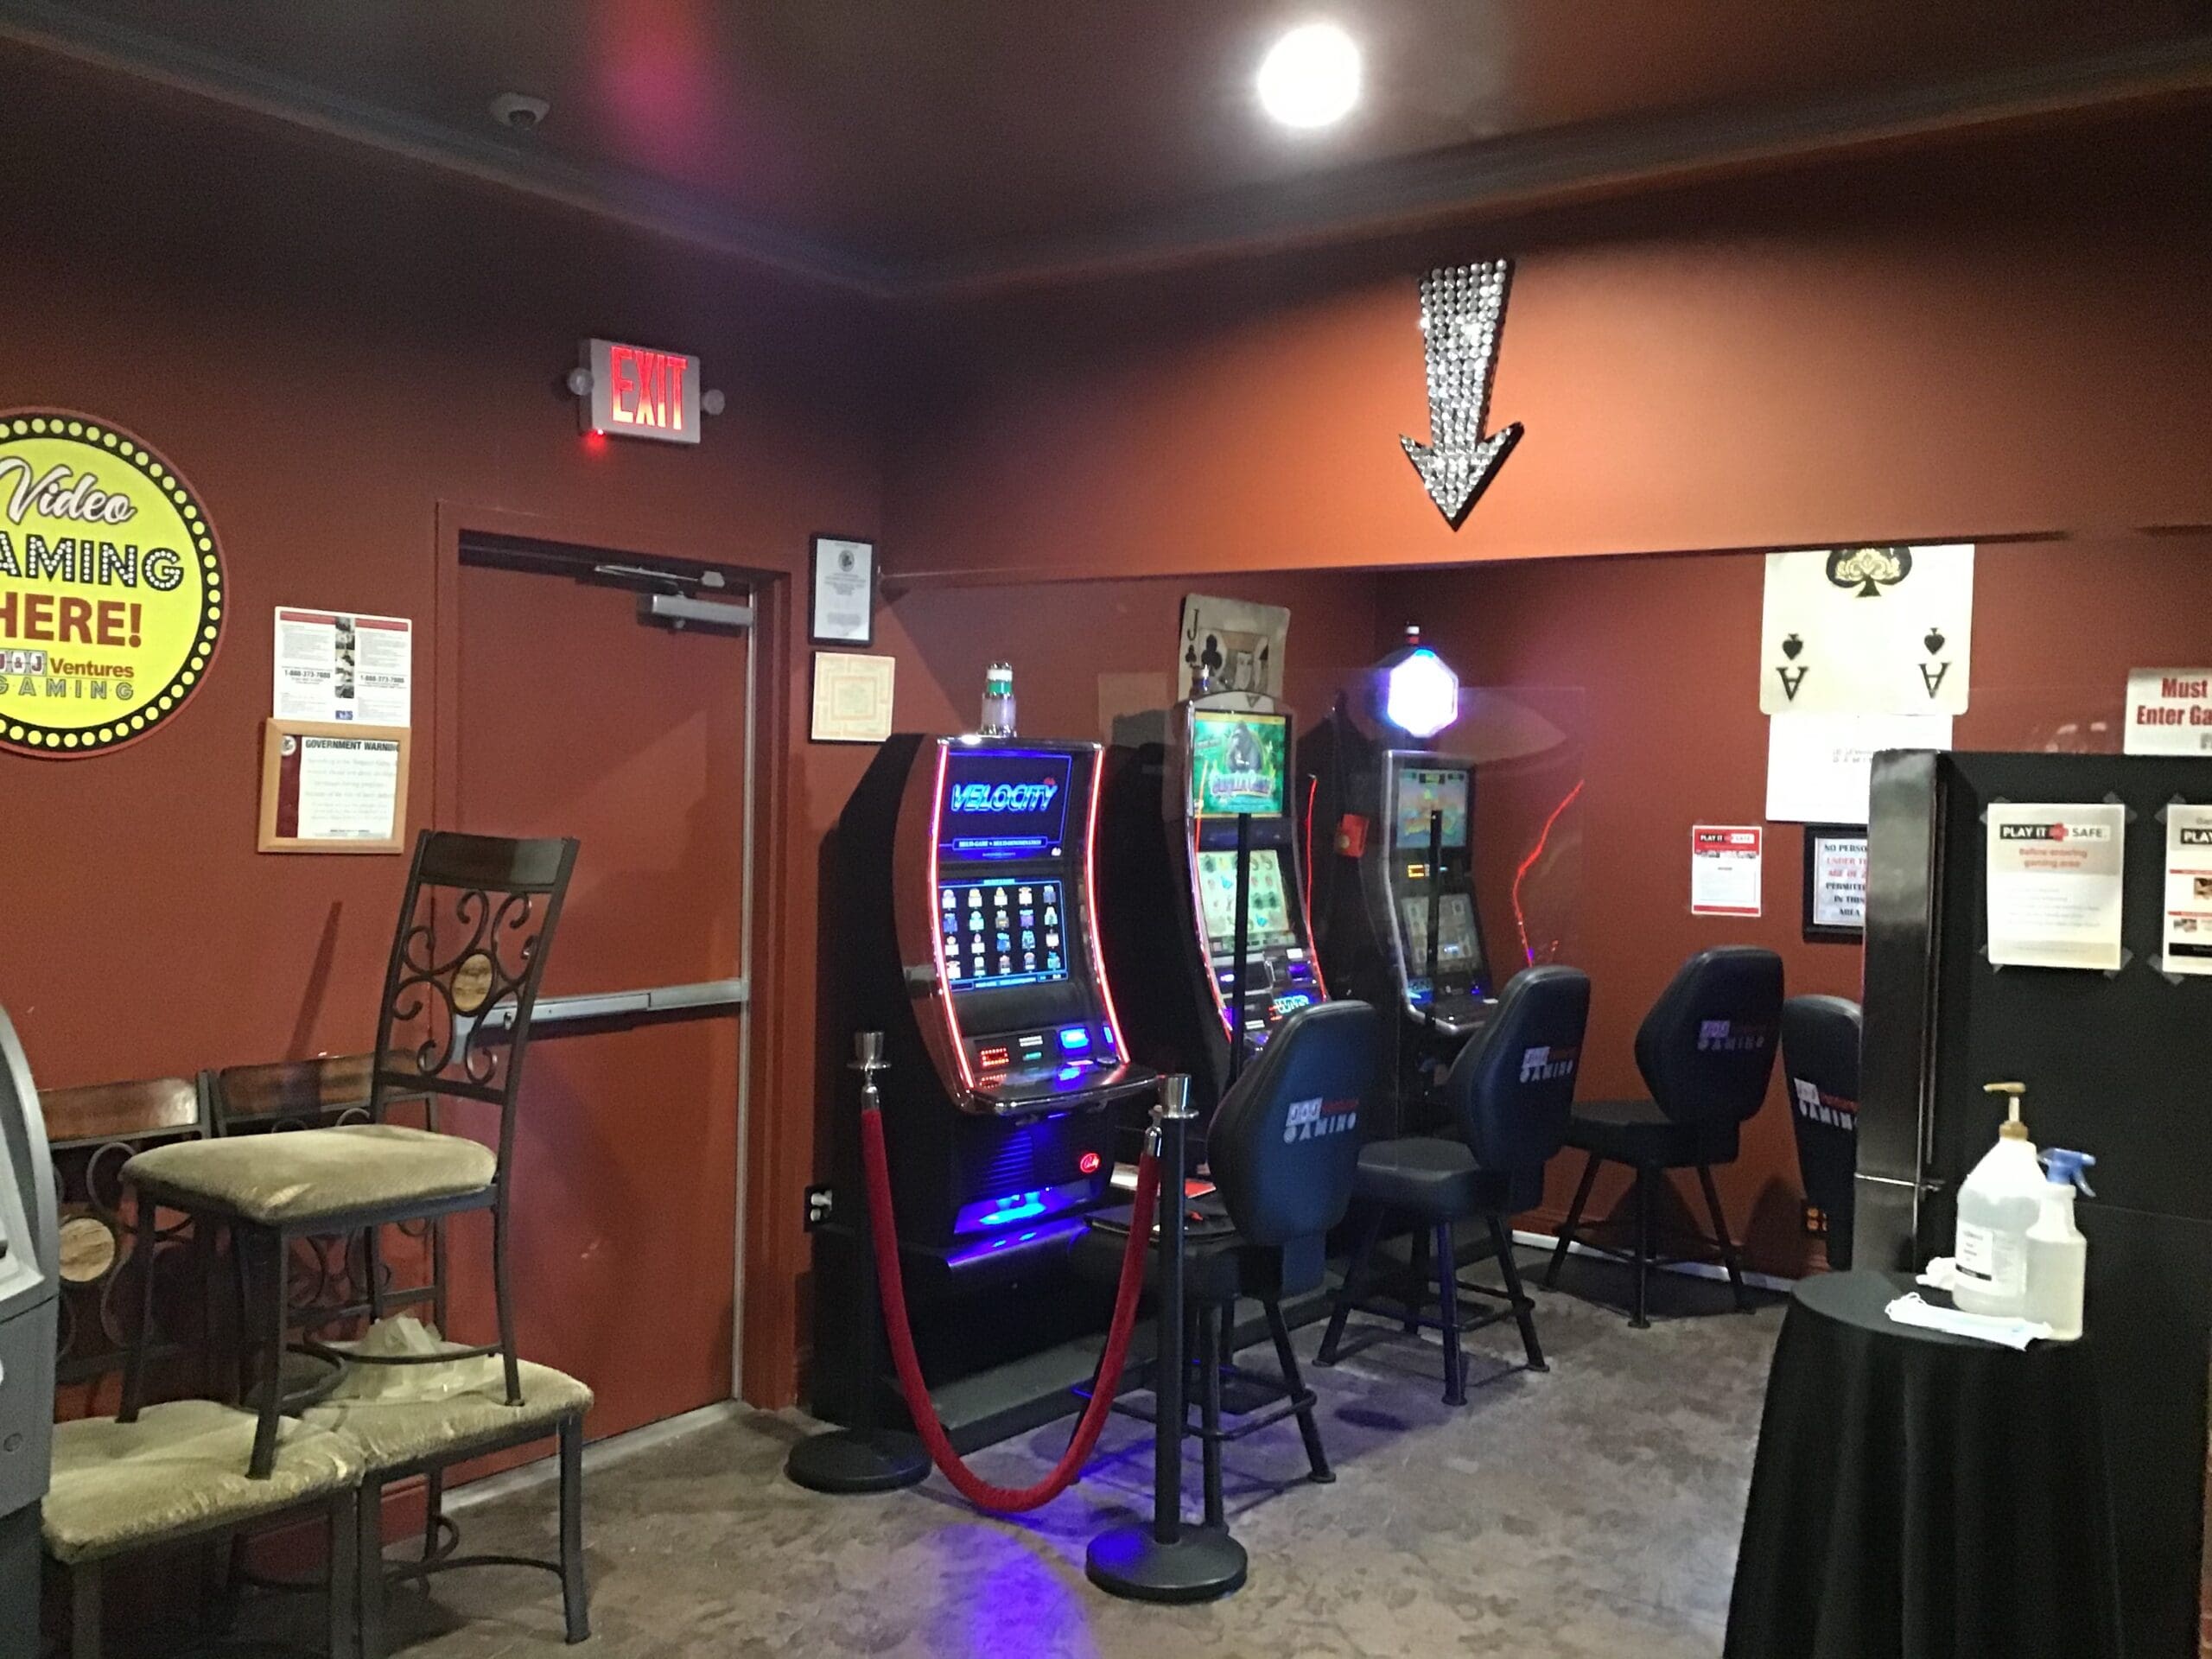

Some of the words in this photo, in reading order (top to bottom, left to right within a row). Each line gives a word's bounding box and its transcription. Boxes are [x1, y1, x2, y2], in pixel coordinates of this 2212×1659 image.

[611, 346, 688, 430] EXIT
[0, 455, 137, 525] Video
[0, 530, 184, 592] AMING
[50, 658, 135, 678] Ventures
[2162, 677, 2208, 698] Must
[2137, 705, 2185, 725] Enter
[2190, 704, 2212, 726] Ga
[306, 740, 361, 750] GOVERNMENT
[950, 783, 1058, 812] VELOCITY
[2003, 827, 2033, 837] PLAY
[2036, 827, 2047, 837] IT
[2072, 828, 2103, 838] SAFE
[1839, 844, 1867, 853] PERSO
